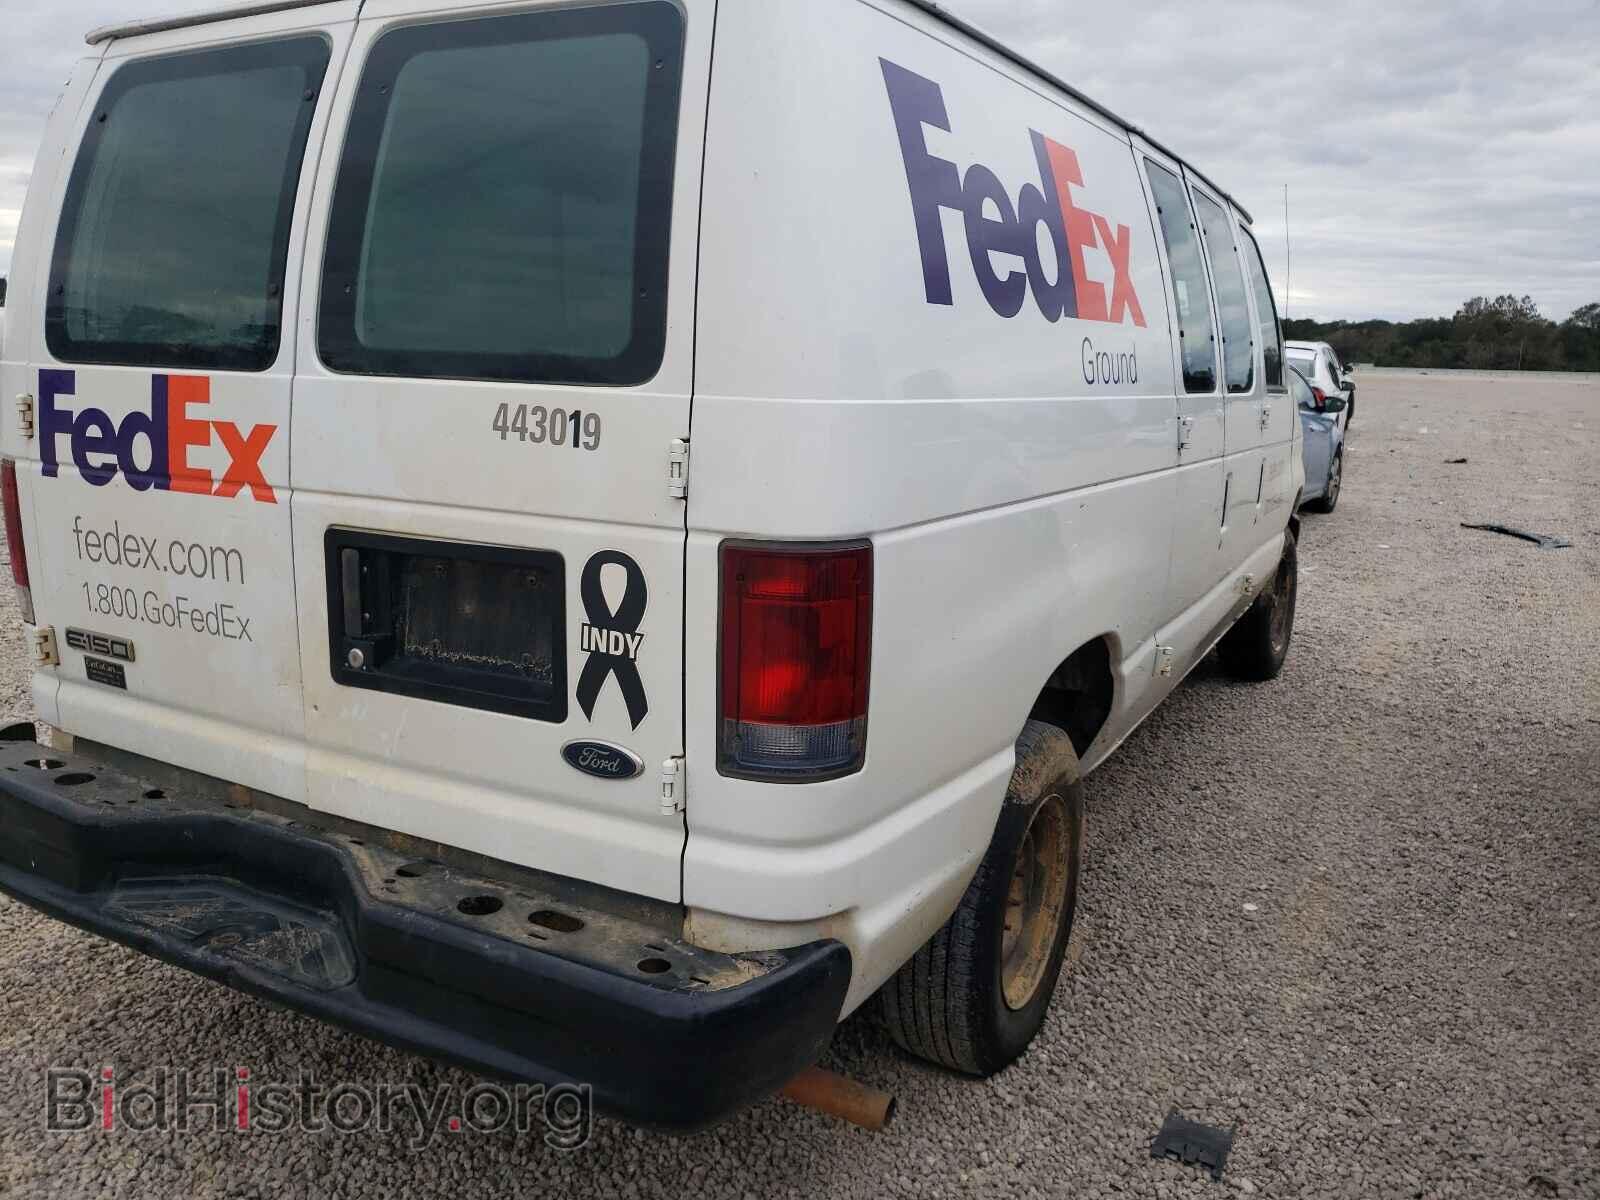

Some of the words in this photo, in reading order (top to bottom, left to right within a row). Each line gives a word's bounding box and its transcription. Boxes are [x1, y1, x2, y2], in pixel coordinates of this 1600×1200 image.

[878, 56, 1148, 328] FedEx
[1081, 336, 1138, 385] Ground
[38, 368, 278, 504] FedEx
[492, 402, 602, 451] 443019
[72, 515, 245, 584] fedex.com
[82, 581, 253, 642] 1.800.GoFedEx
[582, 625, 641, 660] INDY
[578, 747, 621, 773] Ford
